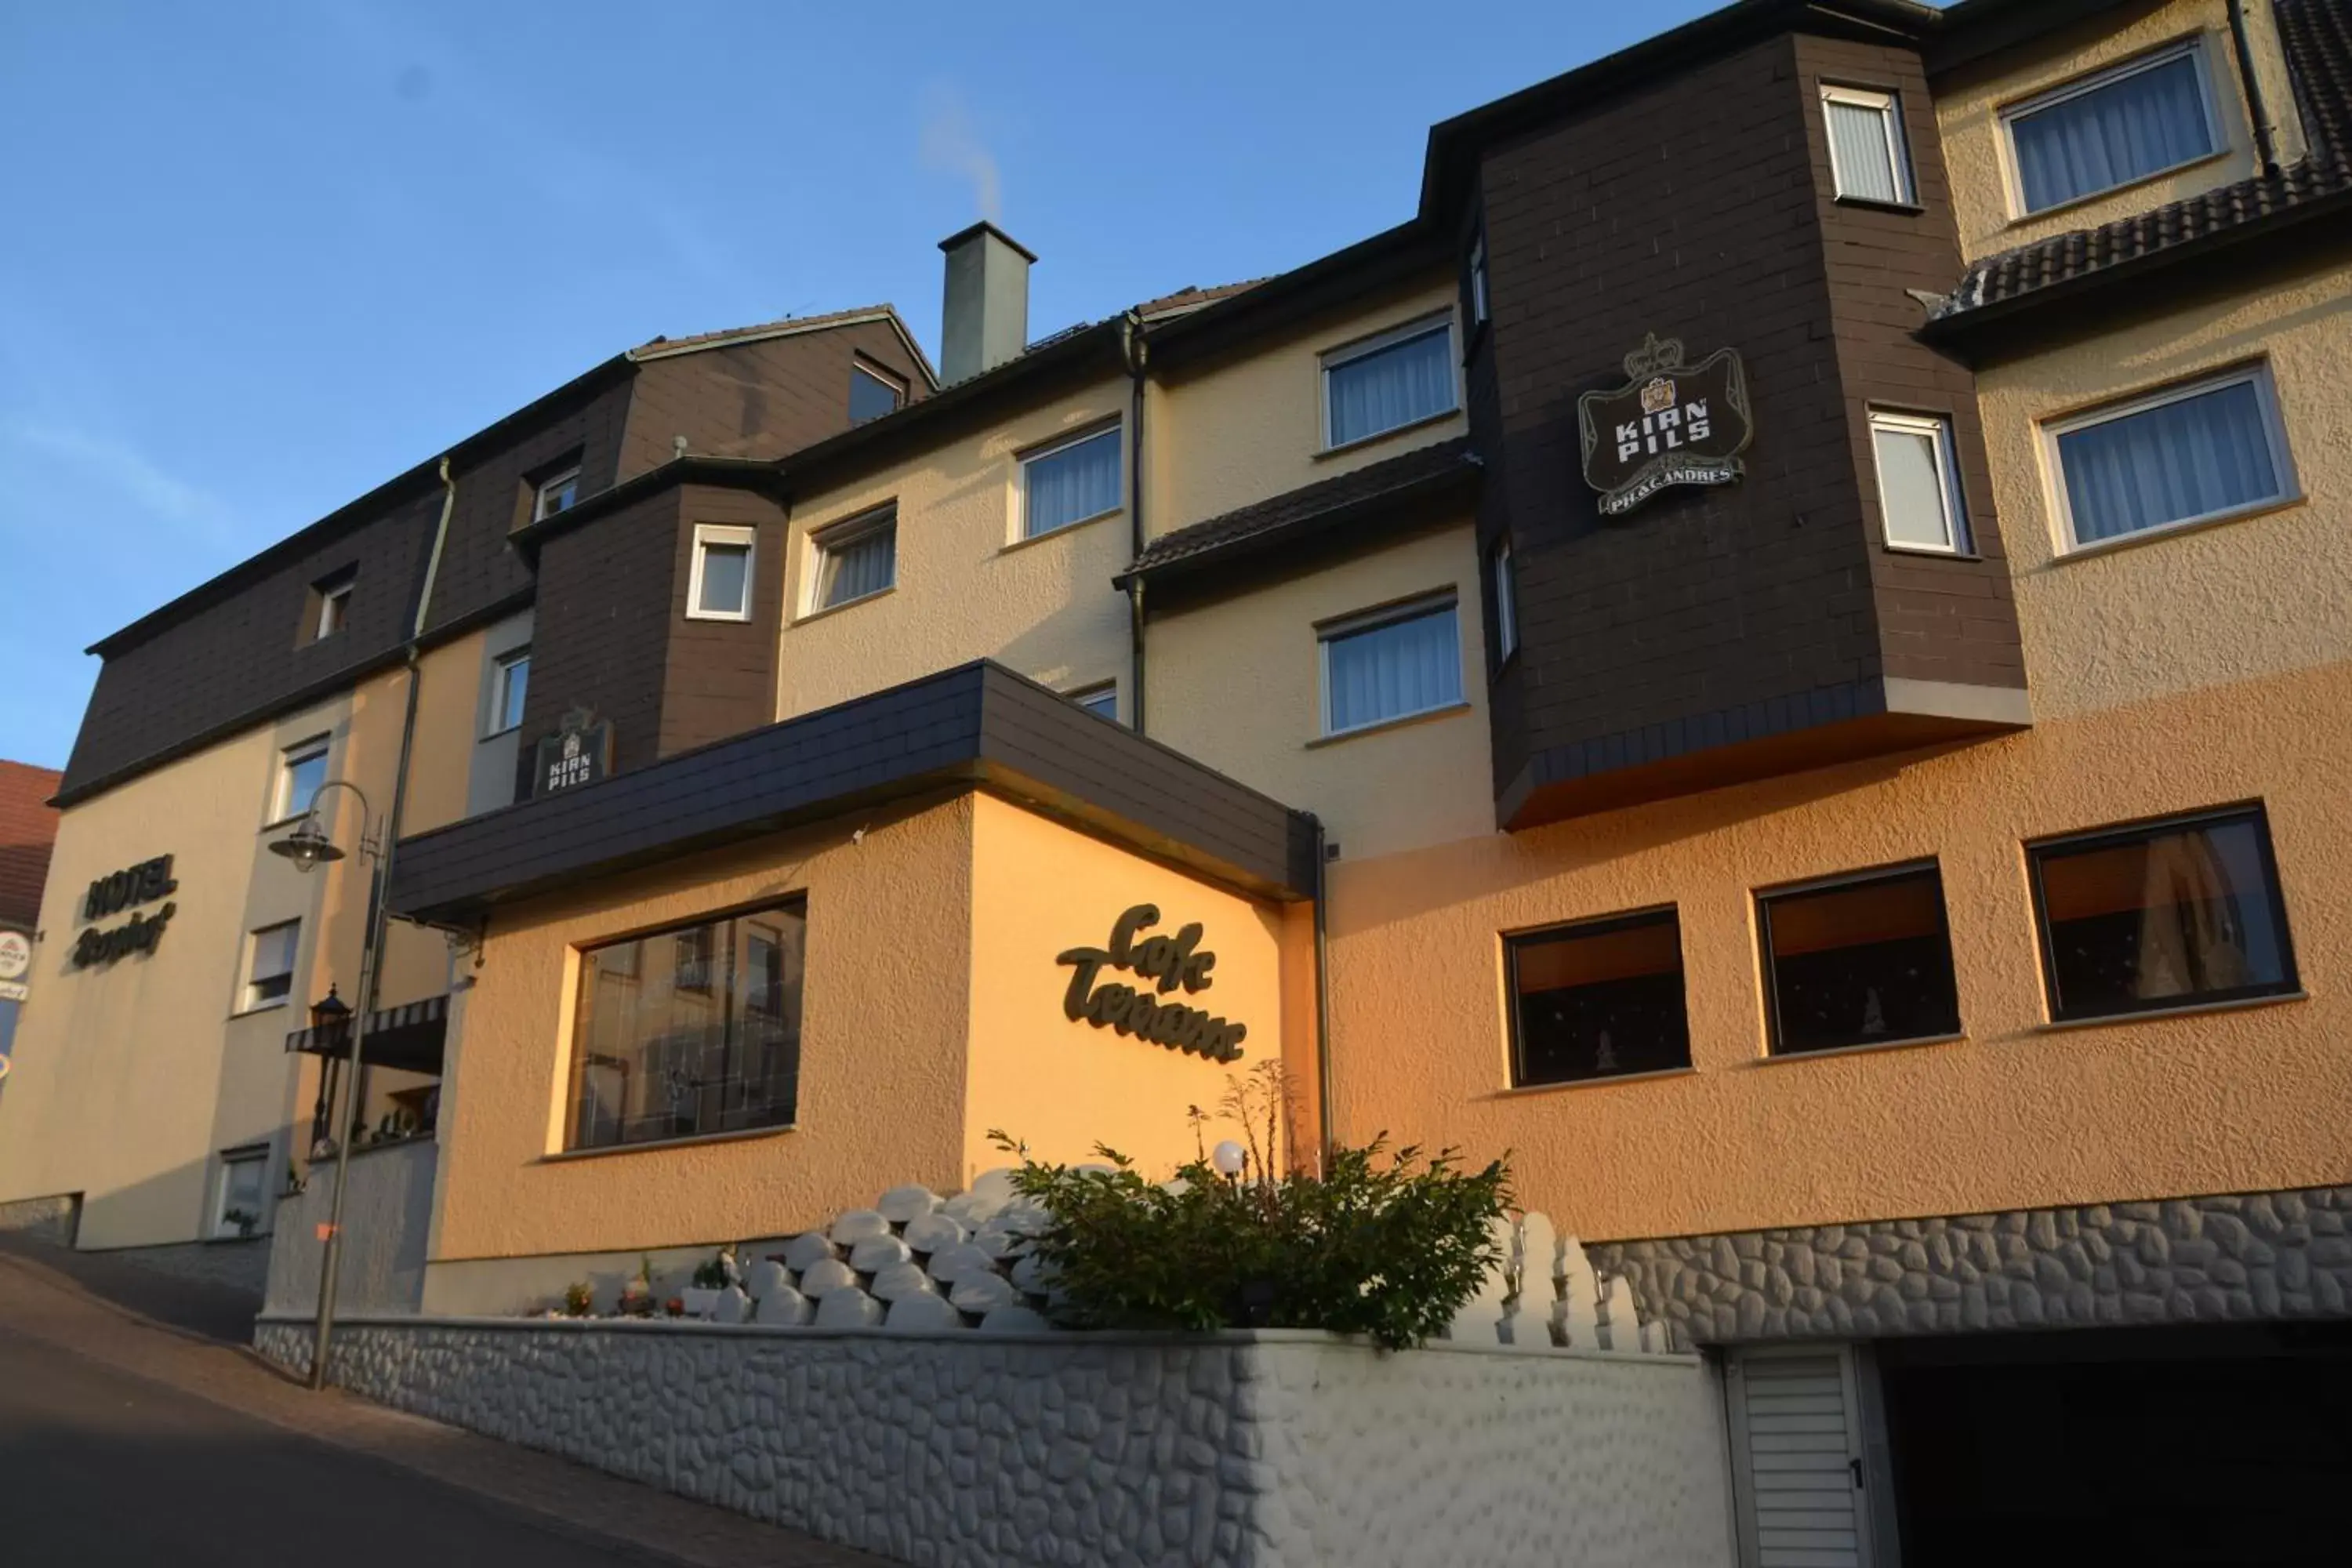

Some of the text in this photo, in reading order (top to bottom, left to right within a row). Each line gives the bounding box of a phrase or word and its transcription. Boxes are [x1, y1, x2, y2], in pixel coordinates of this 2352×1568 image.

[1616, 397, 1708, 442] KIRN
[1618, 419, 1711, 463] PILS
[1663, 469, 1731, 485] ANDRES
[549, 768, 590, 790] PILS
[550, 753, 590, 775] KIRN
[85, 853, 179, 920] HOTEL
[1056, 946, 1247, 1065] Terrasse
